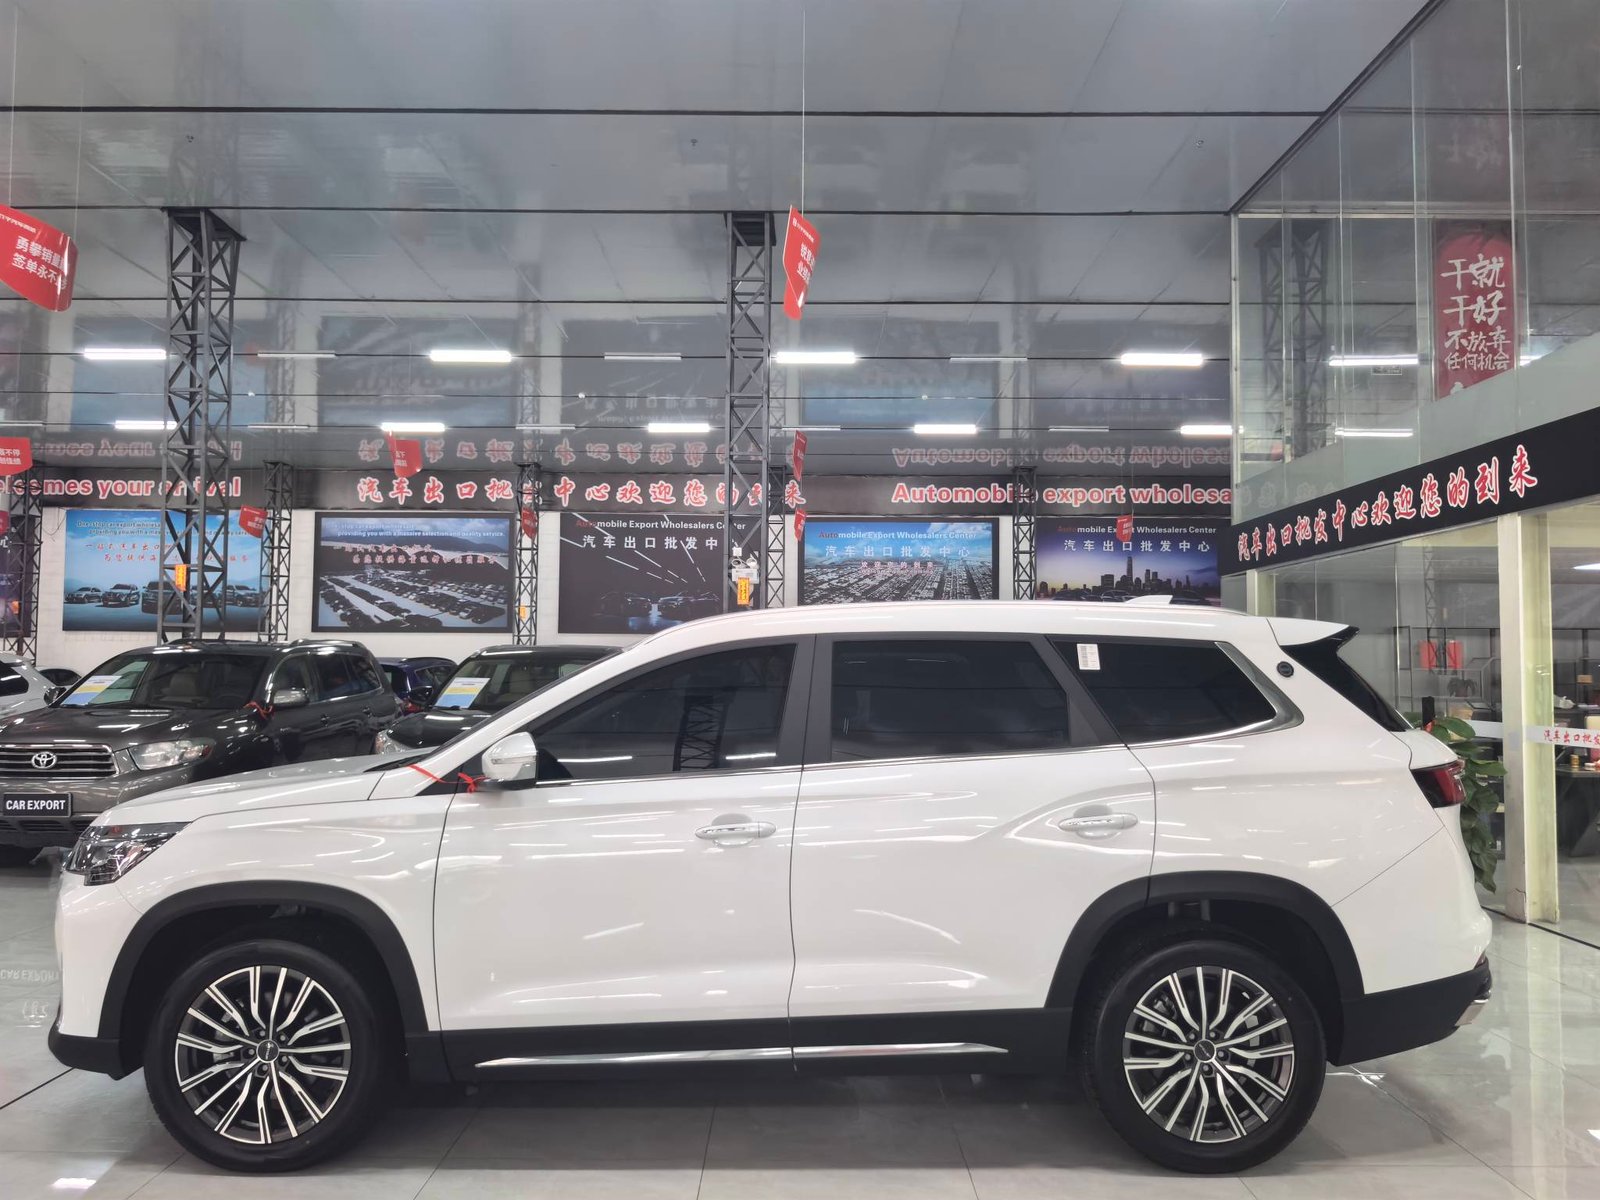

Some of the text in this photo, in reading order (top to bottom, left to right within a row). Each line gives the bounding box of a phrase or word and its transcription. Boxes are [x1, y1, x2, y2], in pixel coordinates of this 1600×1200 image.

[1440, 253, 1505, 290] 干就
[1442, 290, 1506, 326] 干好
[1444, 326, 1511, 353] 不放弃
[1444, 351, 1510, 371] 任何机会
[98, 478, 154, 499] your
[1043, 484, 1125, 507] export
[1130, 483, 1231, 504] wholesa
[1238, 444, 1538, 562] 汽车出口批发中心欢迎您的到来
[629, 520, 659, 529] Export
[661, 520, 715, 529] Wholesalers
[716, 521, 746, 530] Ceer
[1107, 526, 1135, 534] Ext
[1188, 526, 1216, 534] Center
[583, 535, 738, 551] 汽车出口批发中
[867, 531, 895, 540] Export
[896, 531, 948, 539] Wholesalers
[949, 531, 977, 539] Center
[825, 545, 970, 558] 汽车出口批发中心
[1064, 539, 1210, 552] 汽车出口批发中心
[6, 800, 66, 810] CAR EXPORT
